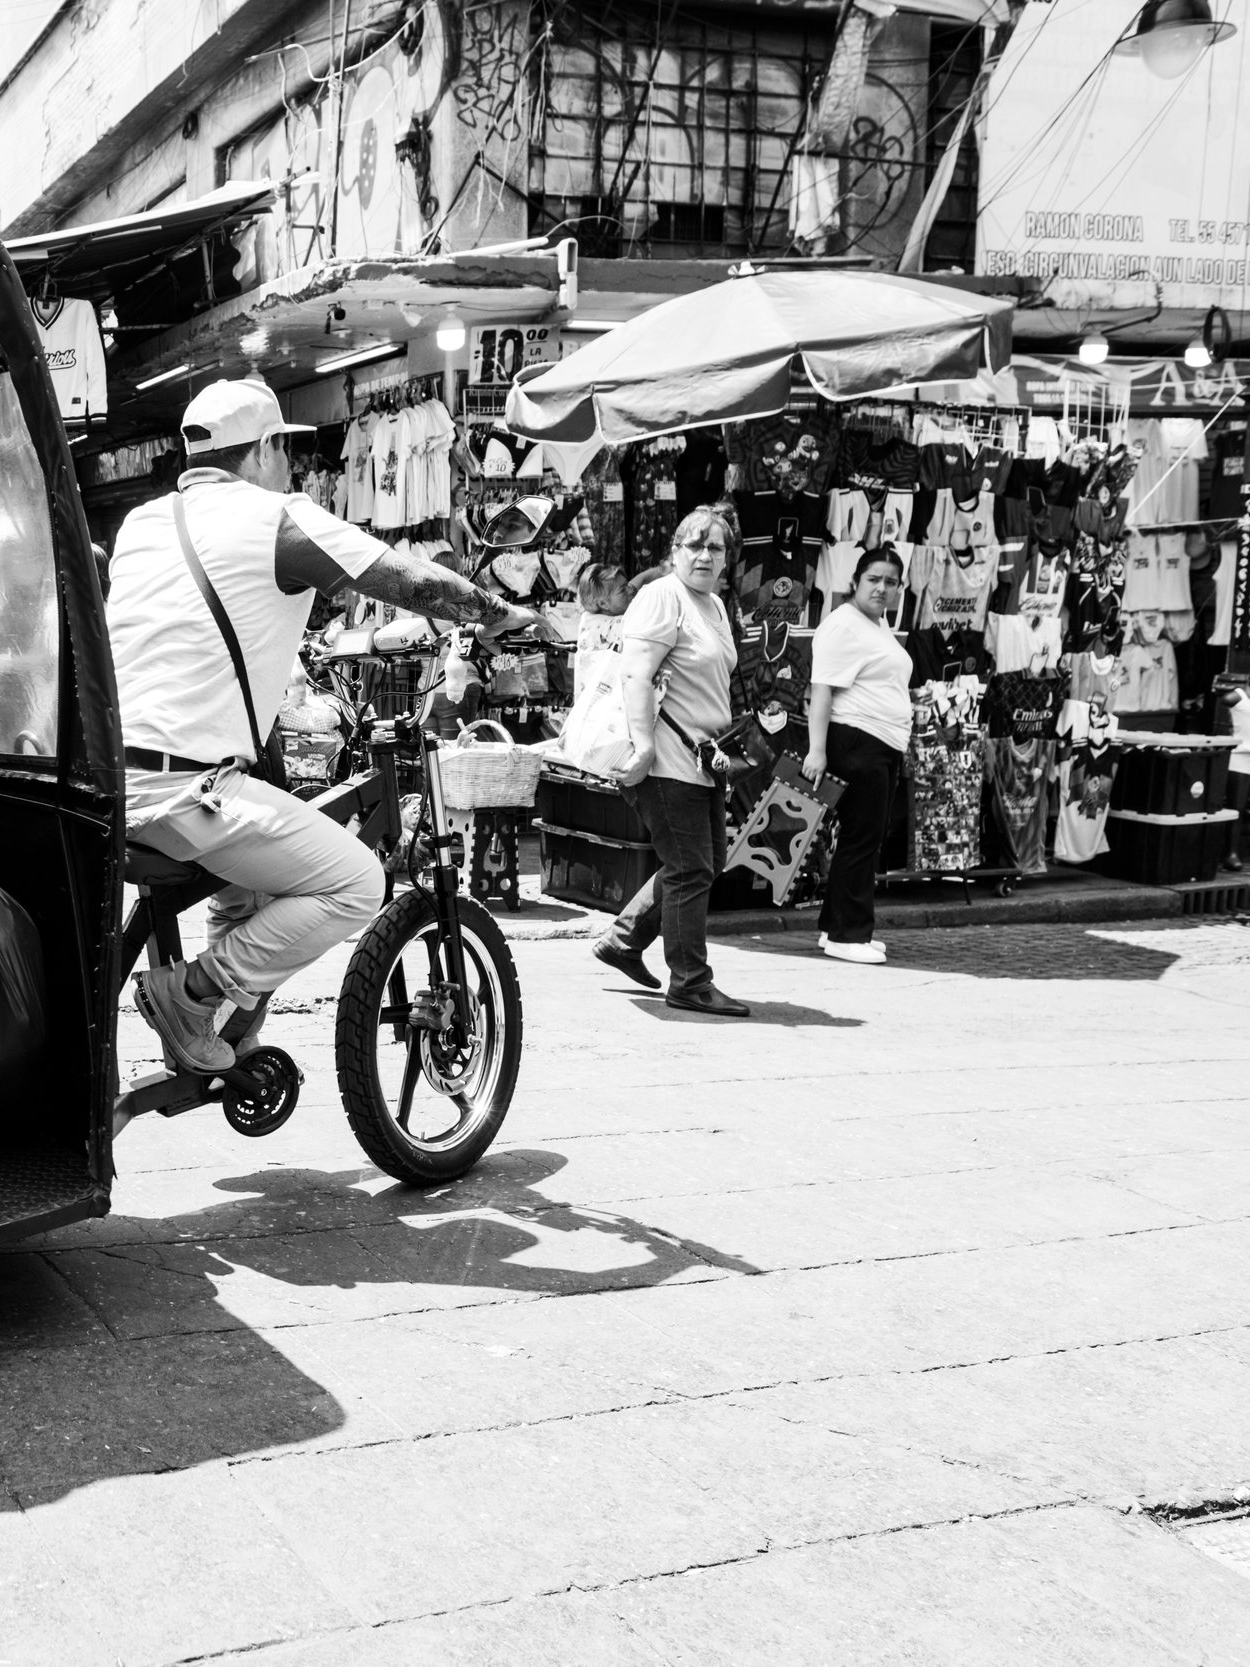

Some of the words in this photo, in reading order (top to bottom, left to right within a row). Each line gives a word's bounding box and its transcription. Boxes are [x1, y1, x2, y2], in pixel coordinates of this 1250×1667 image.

[1025, 211, 1080, 239] RAMON
[1084, 213, 1143, 242] CORONA
[1169, 219, 1195, 243] TEL.
[1023, 251, 1150, 281] CIRCUNVALACION
[1185, 257, 1224, 285] LADO
[1226, 259, 1246, 286] DE
[526, 329, 549, 341] 00
[530, 347, 542, 356] LA
